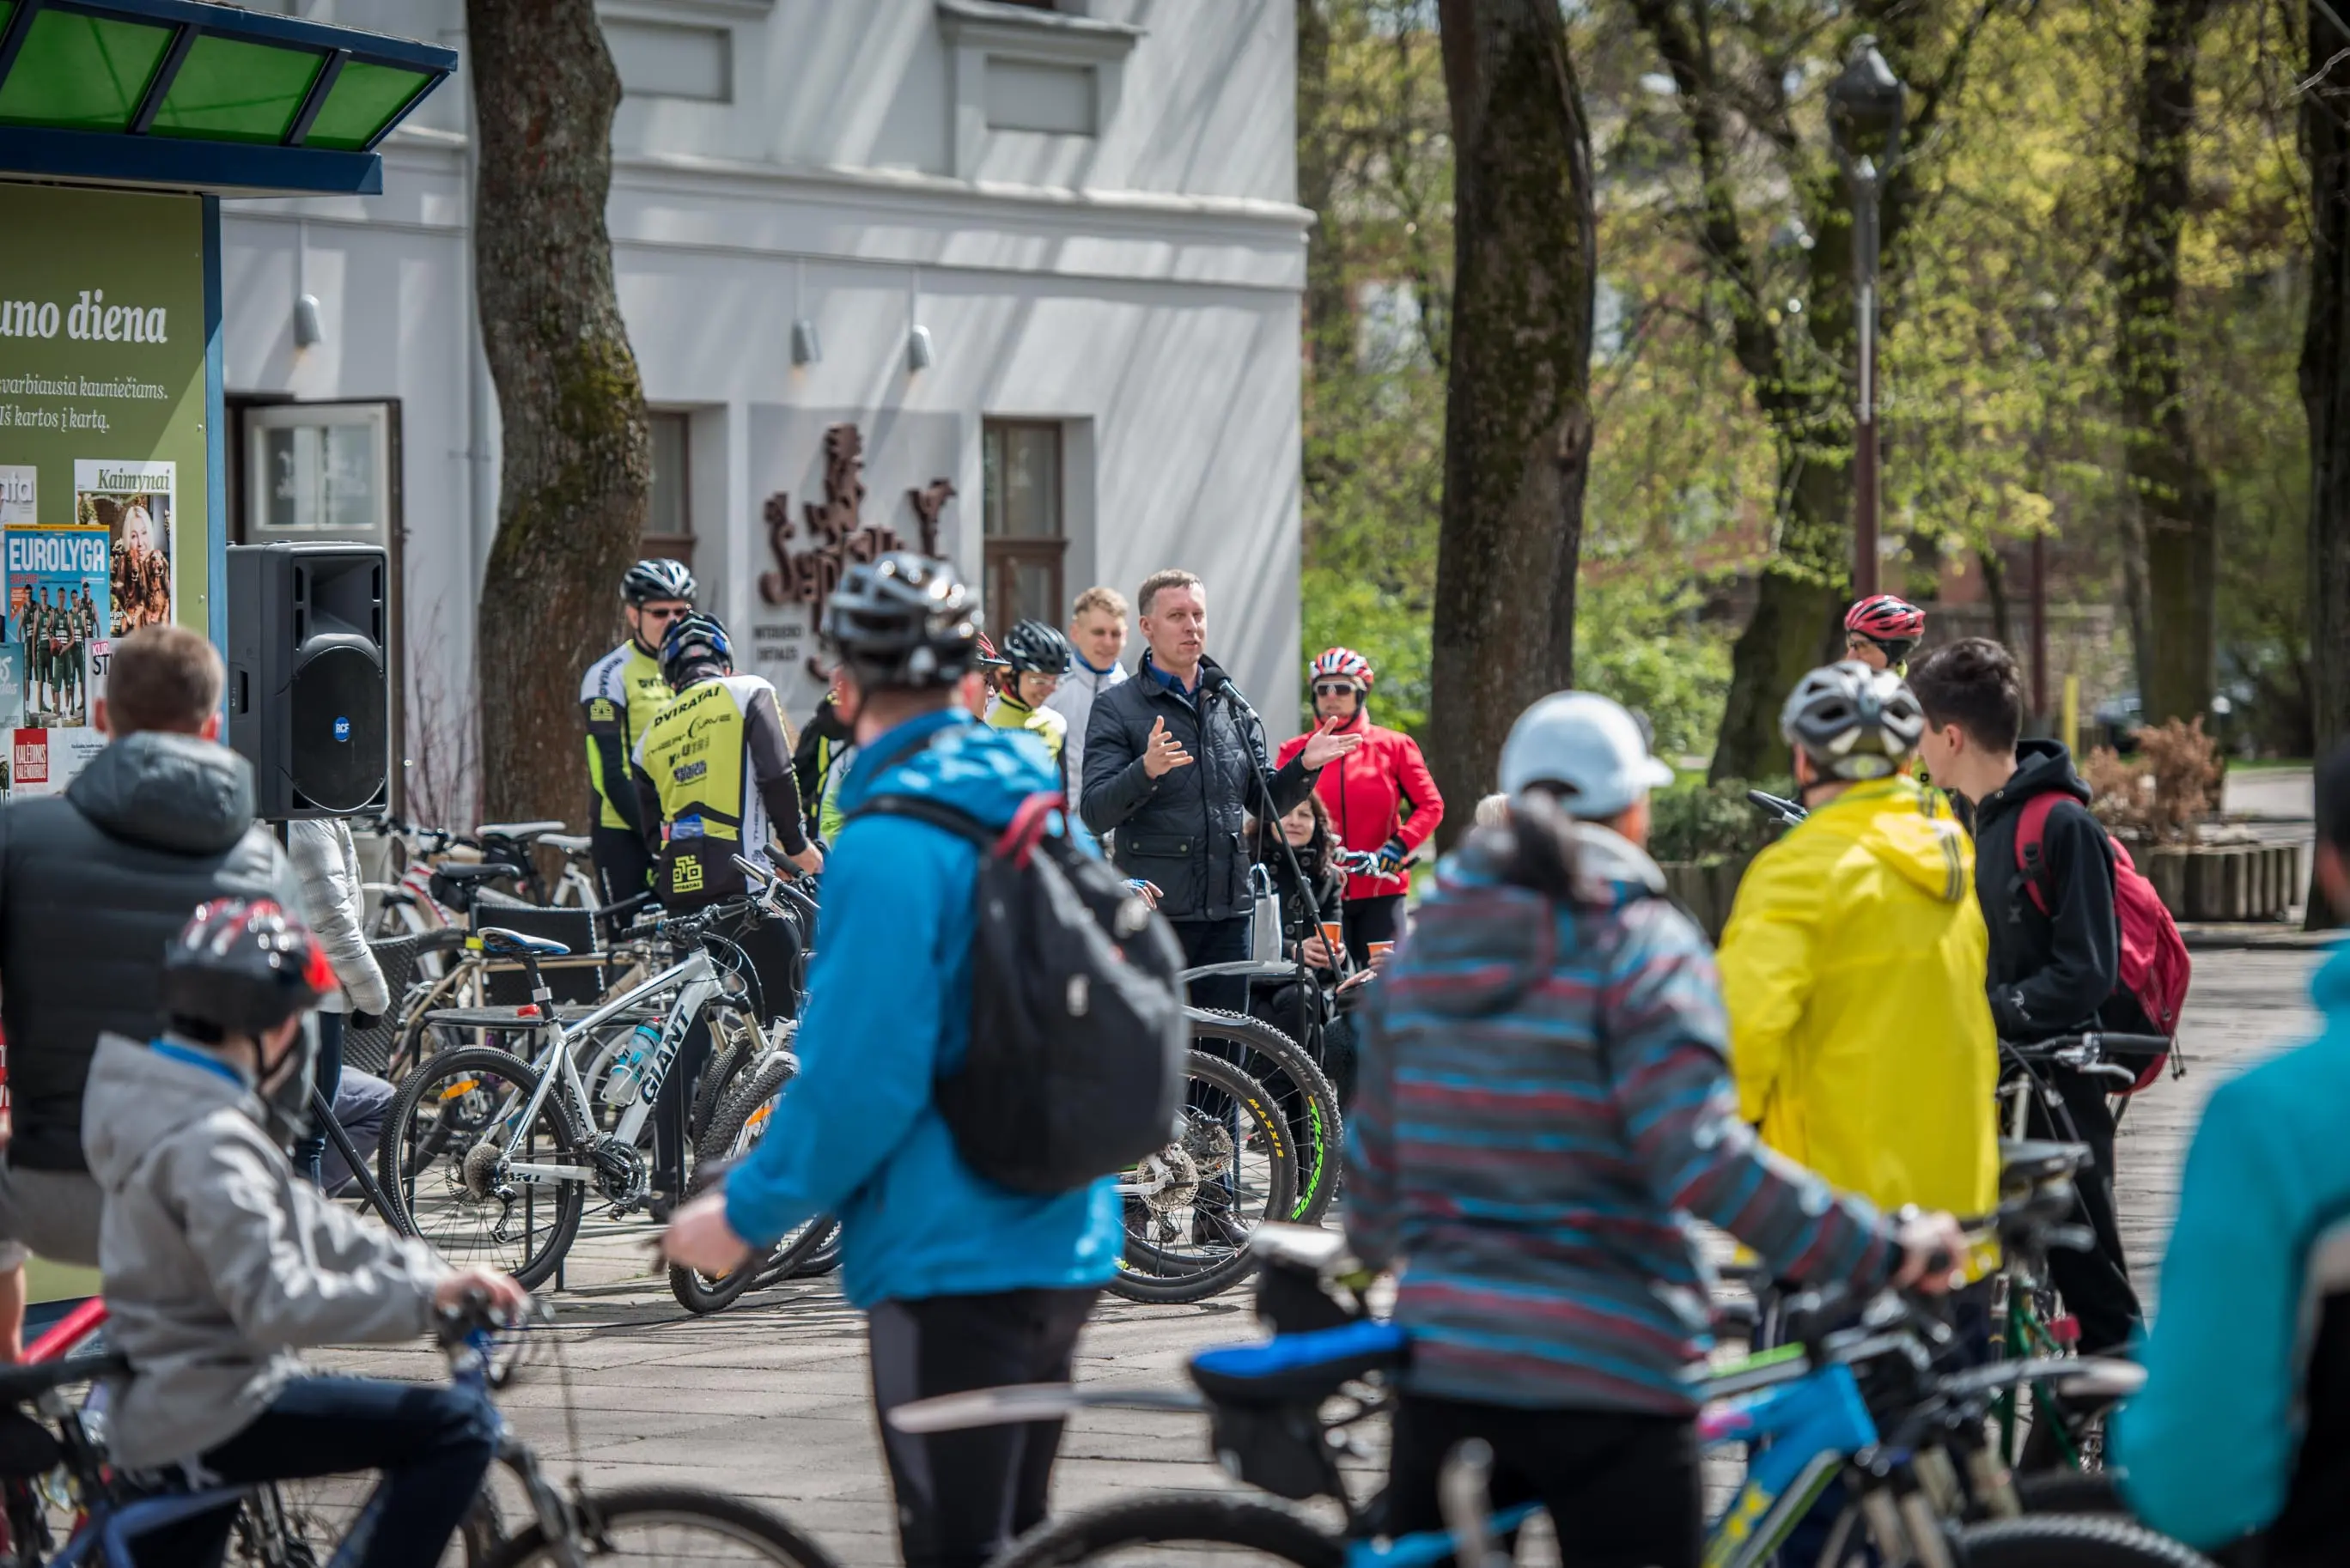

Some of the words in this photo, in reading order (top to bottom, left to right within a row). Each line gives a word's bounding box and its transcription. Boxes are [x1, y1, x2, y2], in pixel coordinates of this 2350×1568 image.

[67, 289, 167, 343] diena
[80, 375, 168, 399] kauniečiams.
[15, 405, 58, 428] kartos
[60, 408, 66, 432] į
[69, 407, 110, 434] kartą.
[97, 467, 170, 493] Kaimynai
[9, 538, 105, 572] EUROLYGA
[93, 653, 112, 676] ST
[653, 686, 721, 728] DVIRATAI
[336, 723, 350, 733] RCF
[641, 1004, 690, 1105] GIANT
[1247, 1097, 1284, 1158] MAXXIS
